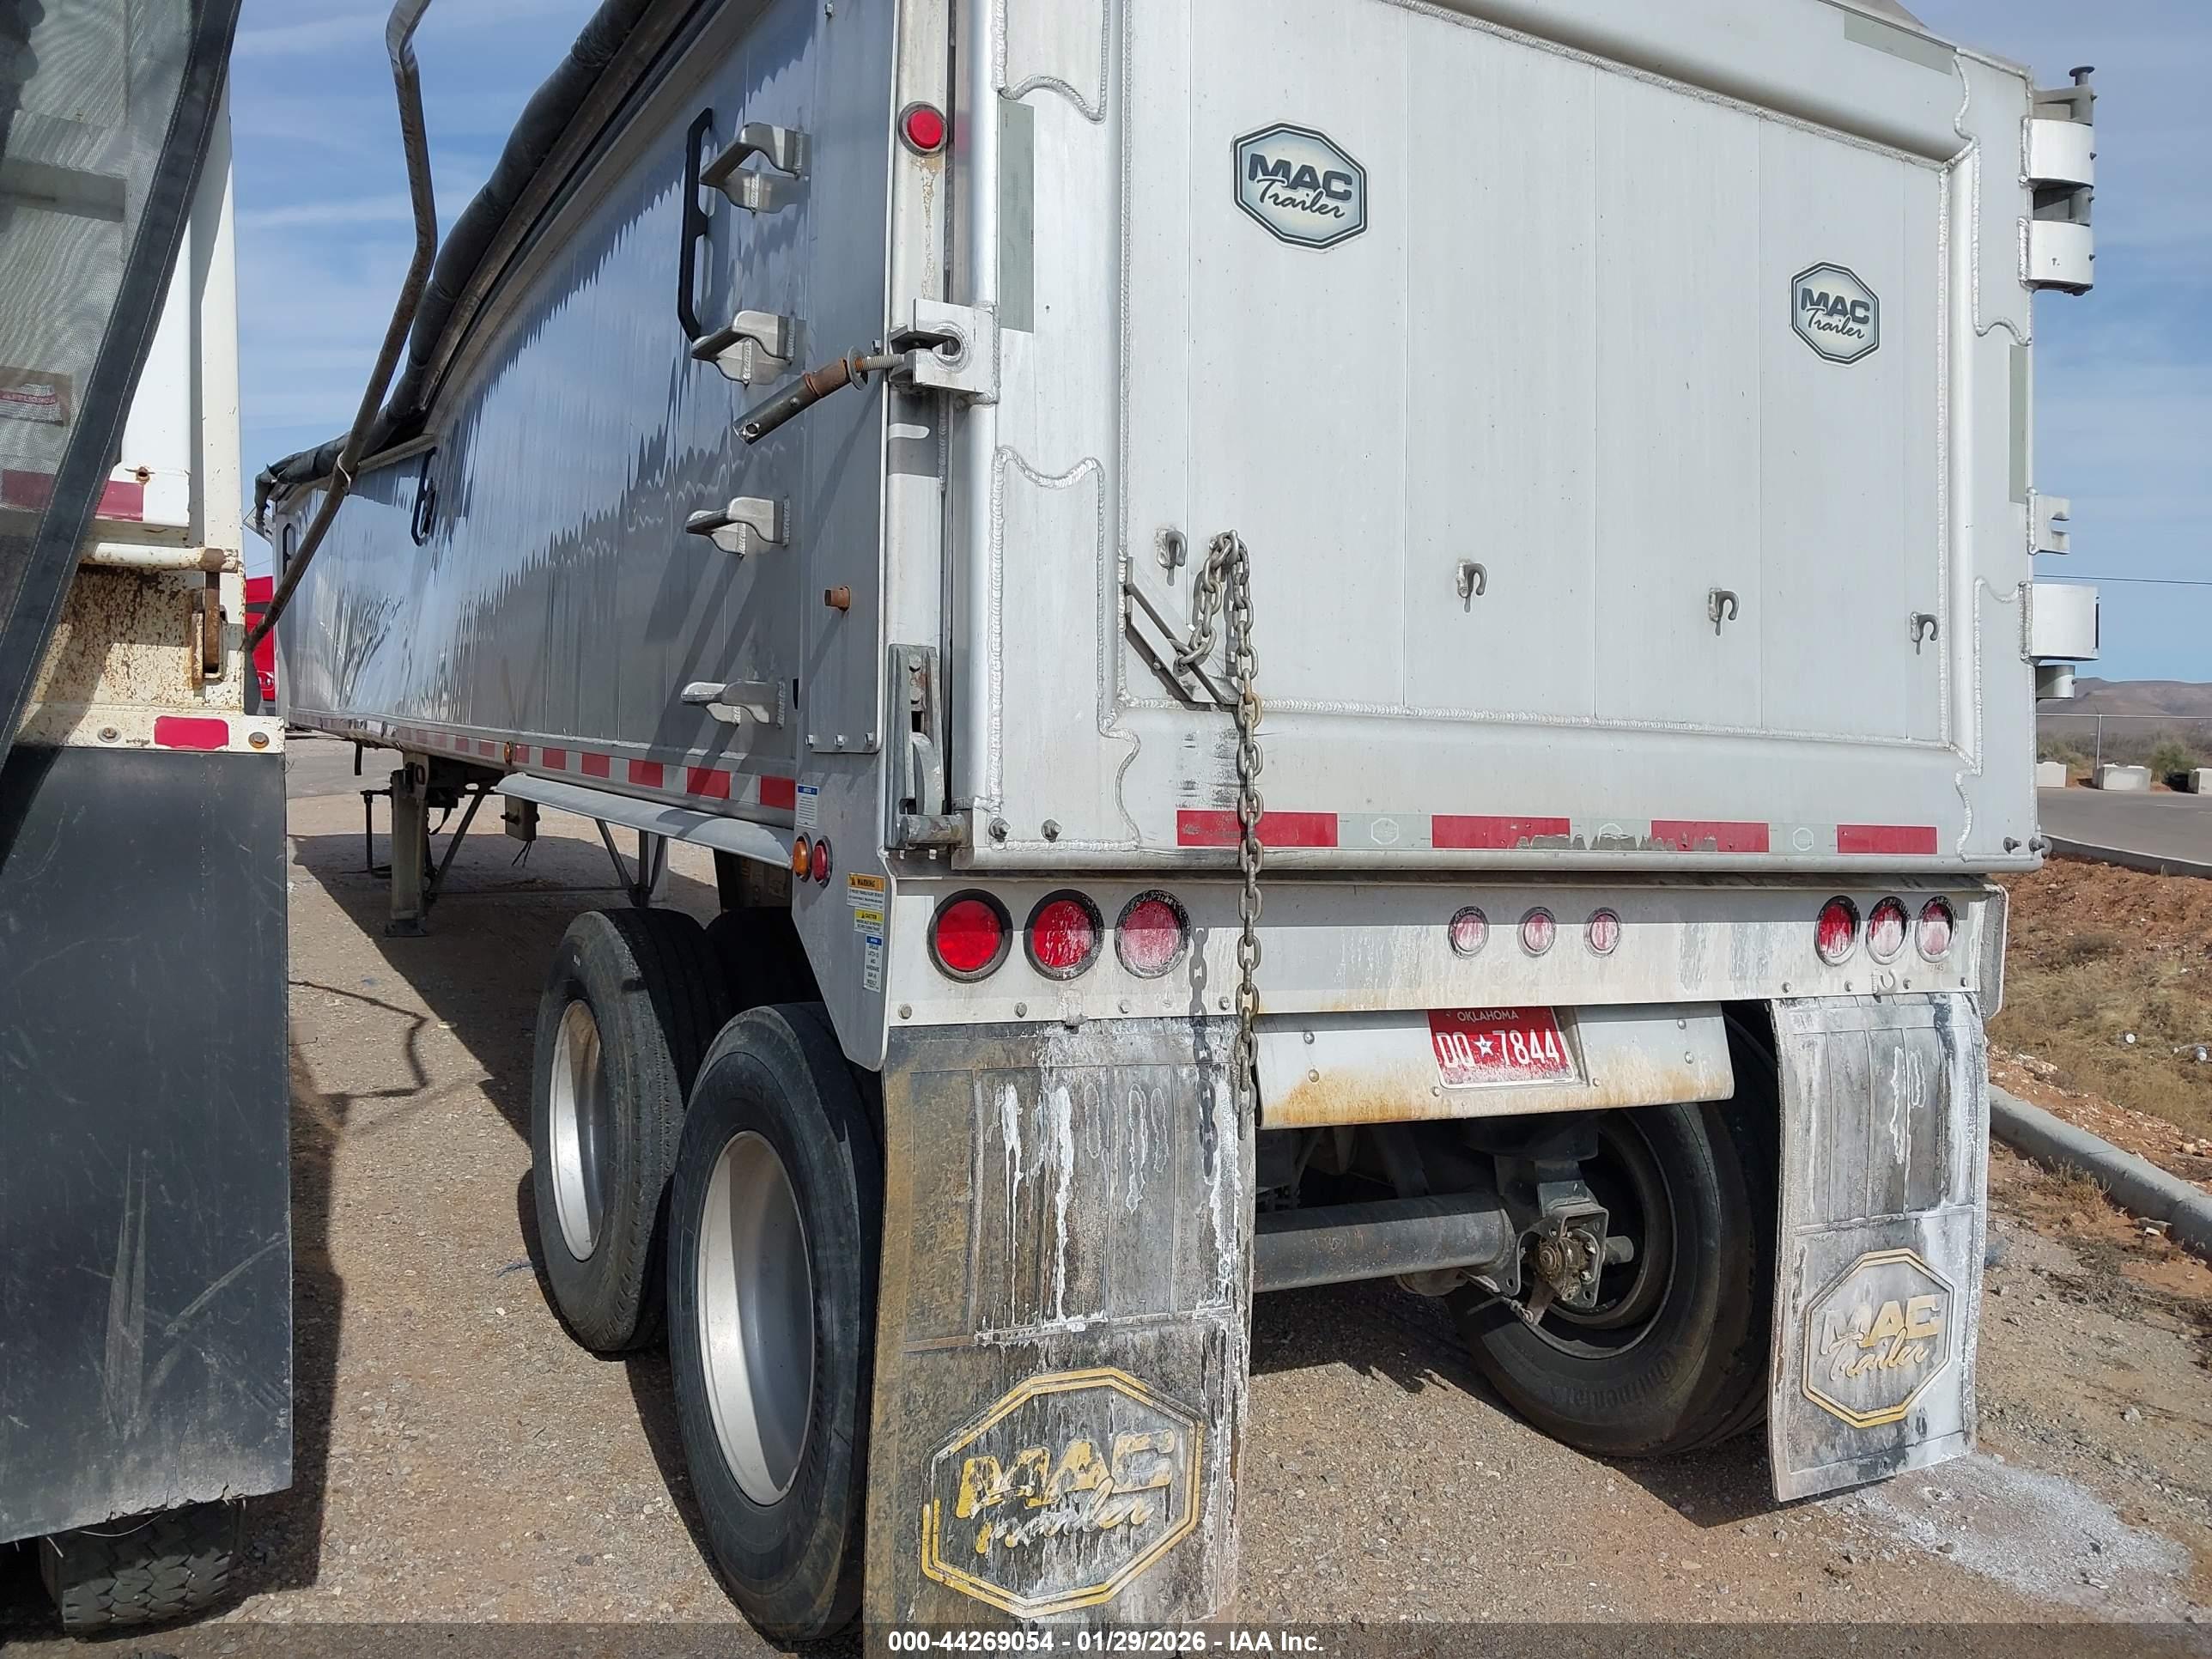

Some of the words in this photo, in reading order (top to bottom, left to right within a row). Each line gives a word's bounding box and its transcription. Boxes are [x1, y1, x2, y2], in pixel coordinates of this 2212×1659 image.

[1249, 153, 1353, 201] MAC
[1255, 178, 1346, 219] Trailer
[1801, 287, 1870, 325] MAC
[1806, 307, 1865, 339] Trailer
[1456, 1009, 1519, 1024] OKLAHOMA
[1492, 1028, 1561, 1067] 7844
[1820, 1293, 1944, 1355] MAC
[1827, 1327, 1929, 1382] Trailer
[955, 1428, 1176, 1519] MAC
